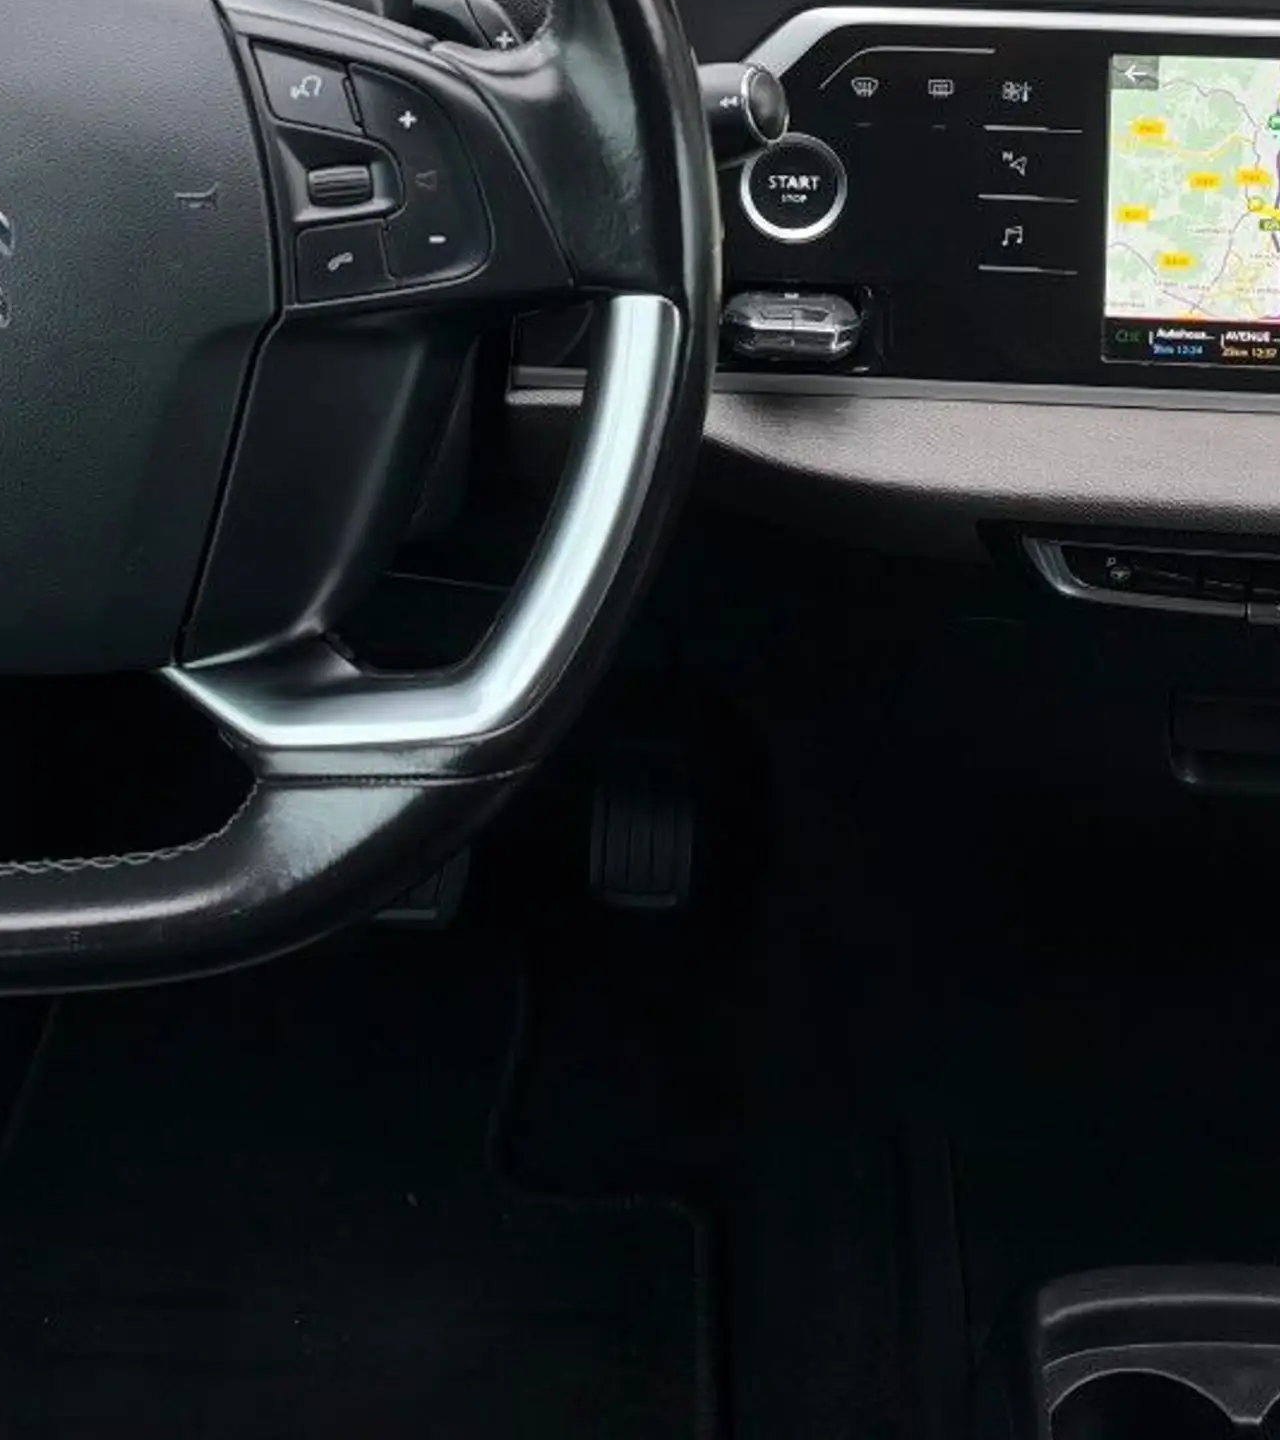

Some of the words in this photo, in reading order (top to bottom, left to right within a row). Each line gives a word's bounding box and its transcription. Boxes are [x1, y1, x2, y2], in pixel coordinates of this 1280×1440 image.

[768, 174, 820, 191] START
[780, 193, 808, 204] STOP
[1225, 329, 1271, 344] AVENUE
